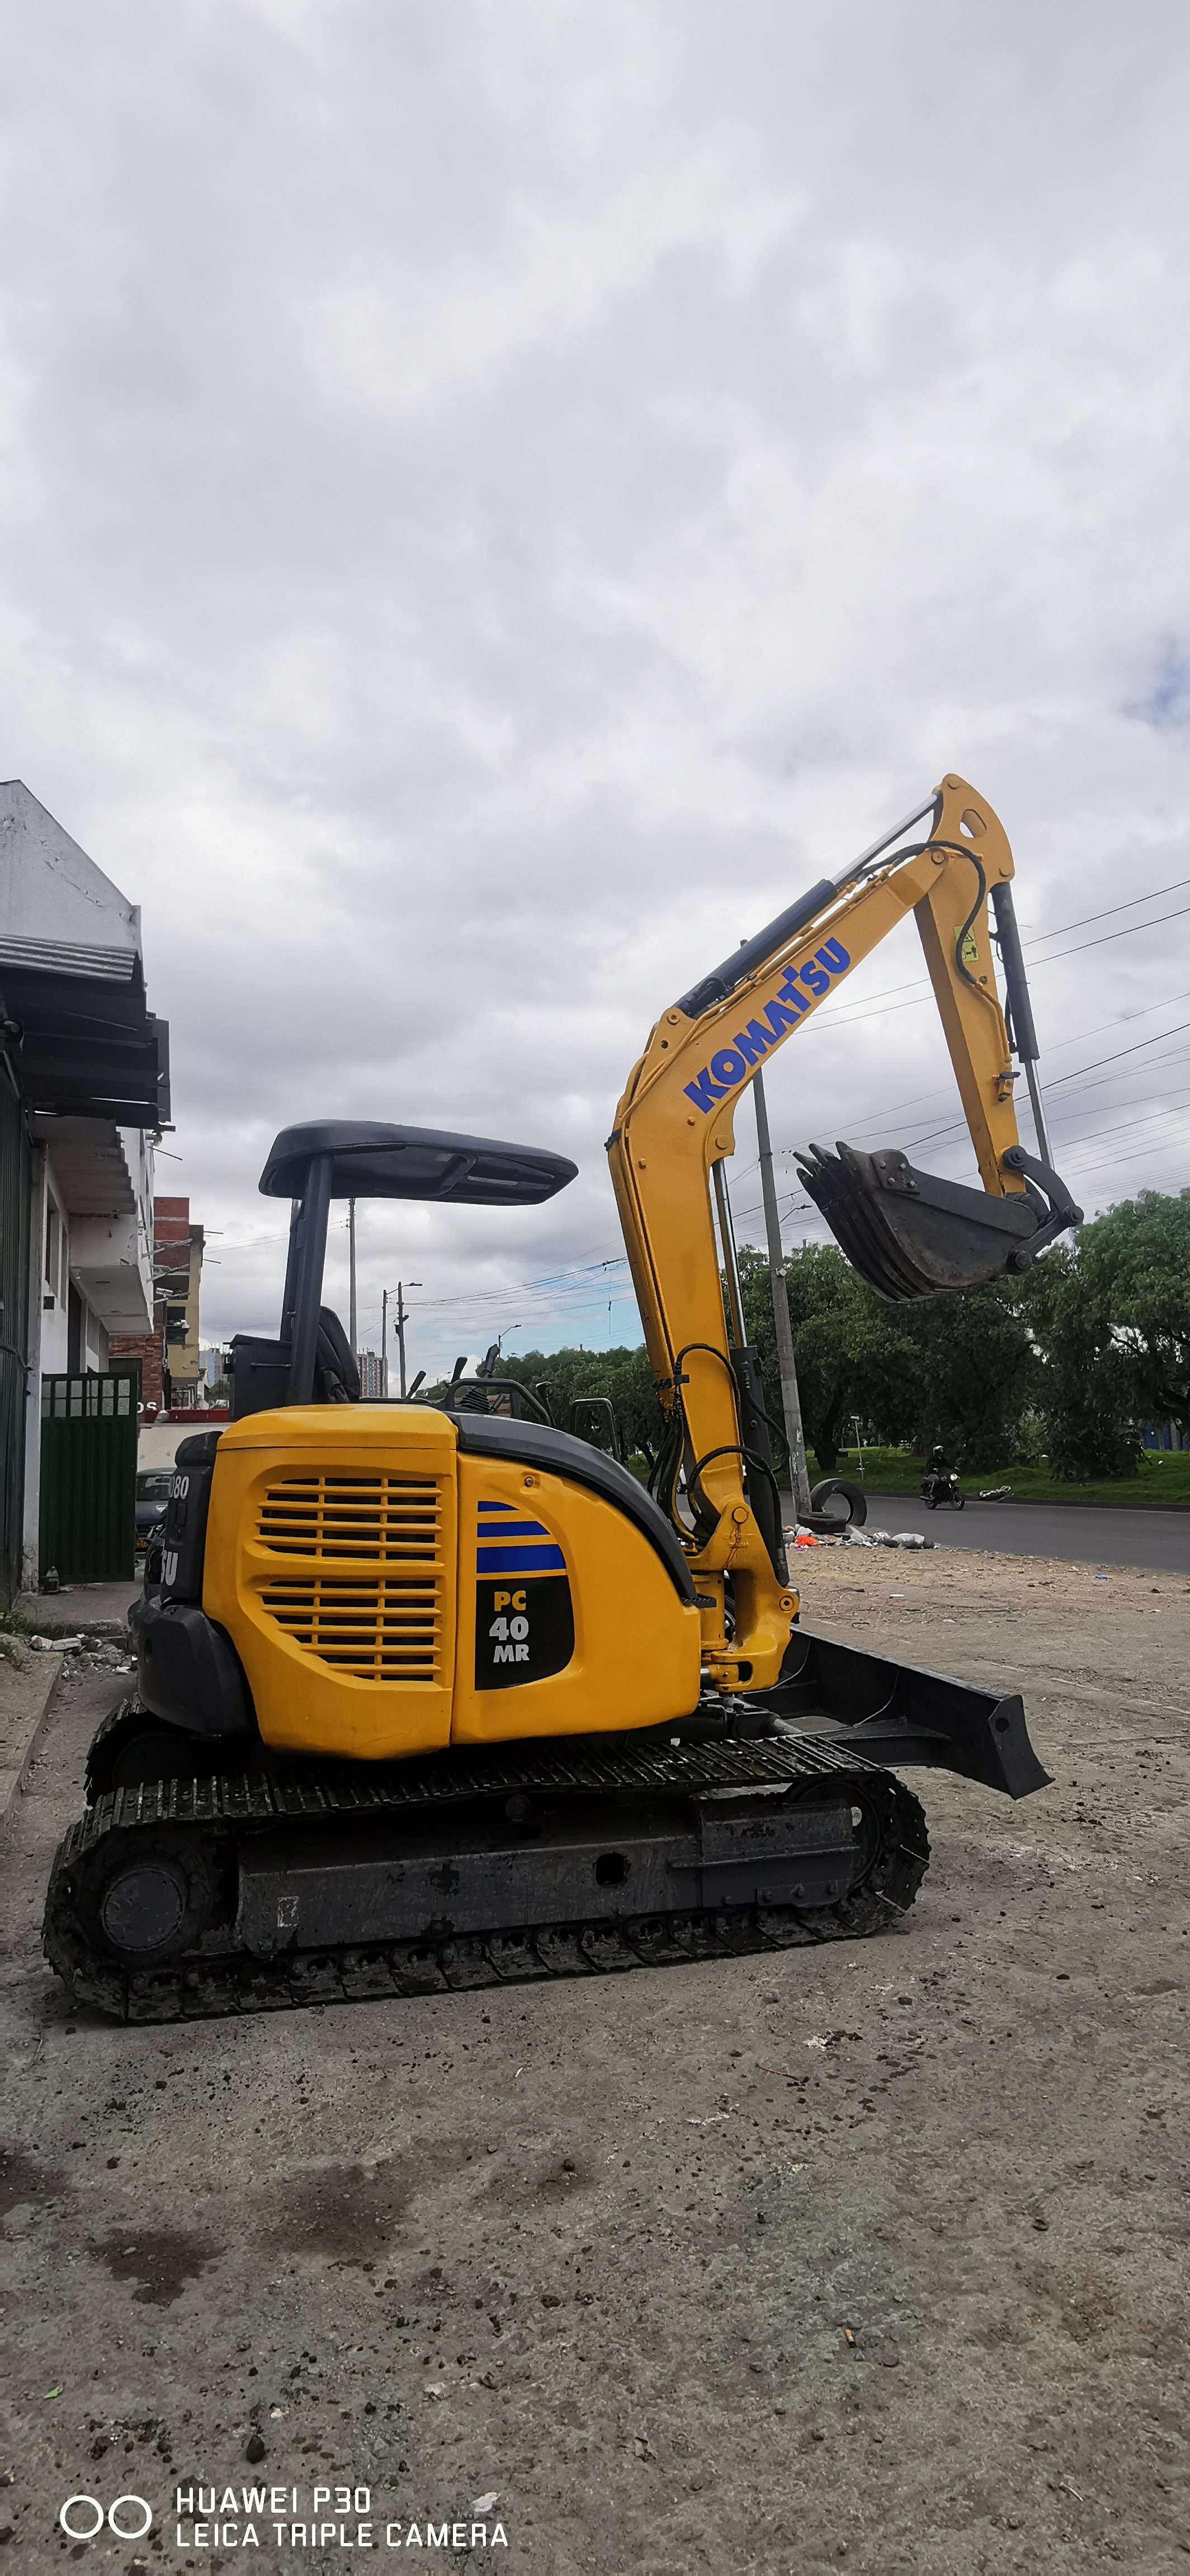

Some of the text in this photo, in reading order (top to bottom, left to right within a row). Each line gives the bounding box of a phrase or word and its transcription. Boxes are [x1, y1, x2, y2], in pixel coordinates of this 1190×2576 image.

[683, 937, 851, 1114] KOMATSU
[494, 1590, 527, 1612] PC
[489, 1616, 529, 1641] 40
[493, 1644, 530, 1663] MR
